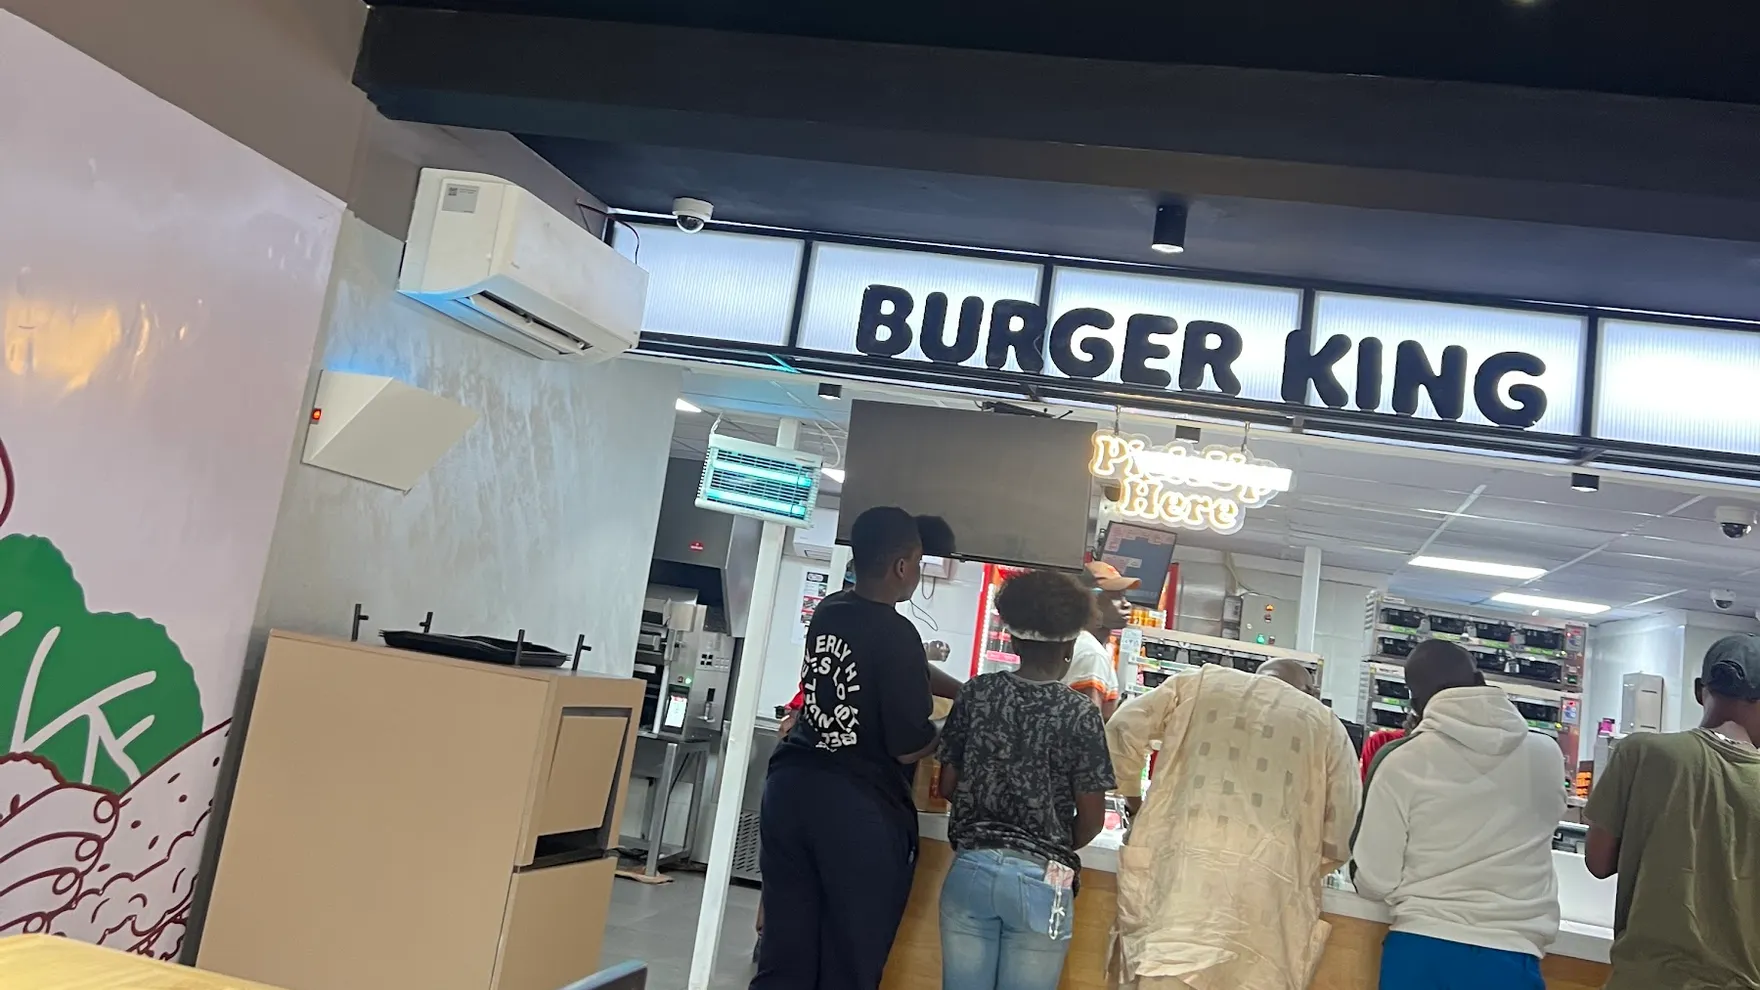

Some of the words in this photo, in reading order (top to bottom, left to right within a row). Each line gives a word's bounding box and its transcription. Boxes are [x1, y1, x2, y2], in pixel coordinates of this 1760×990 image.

[855, 284, 1243, 398] BURGER
[1281, 328, 1548, 428] KING
[1121, 477, 1239, 530] Here
